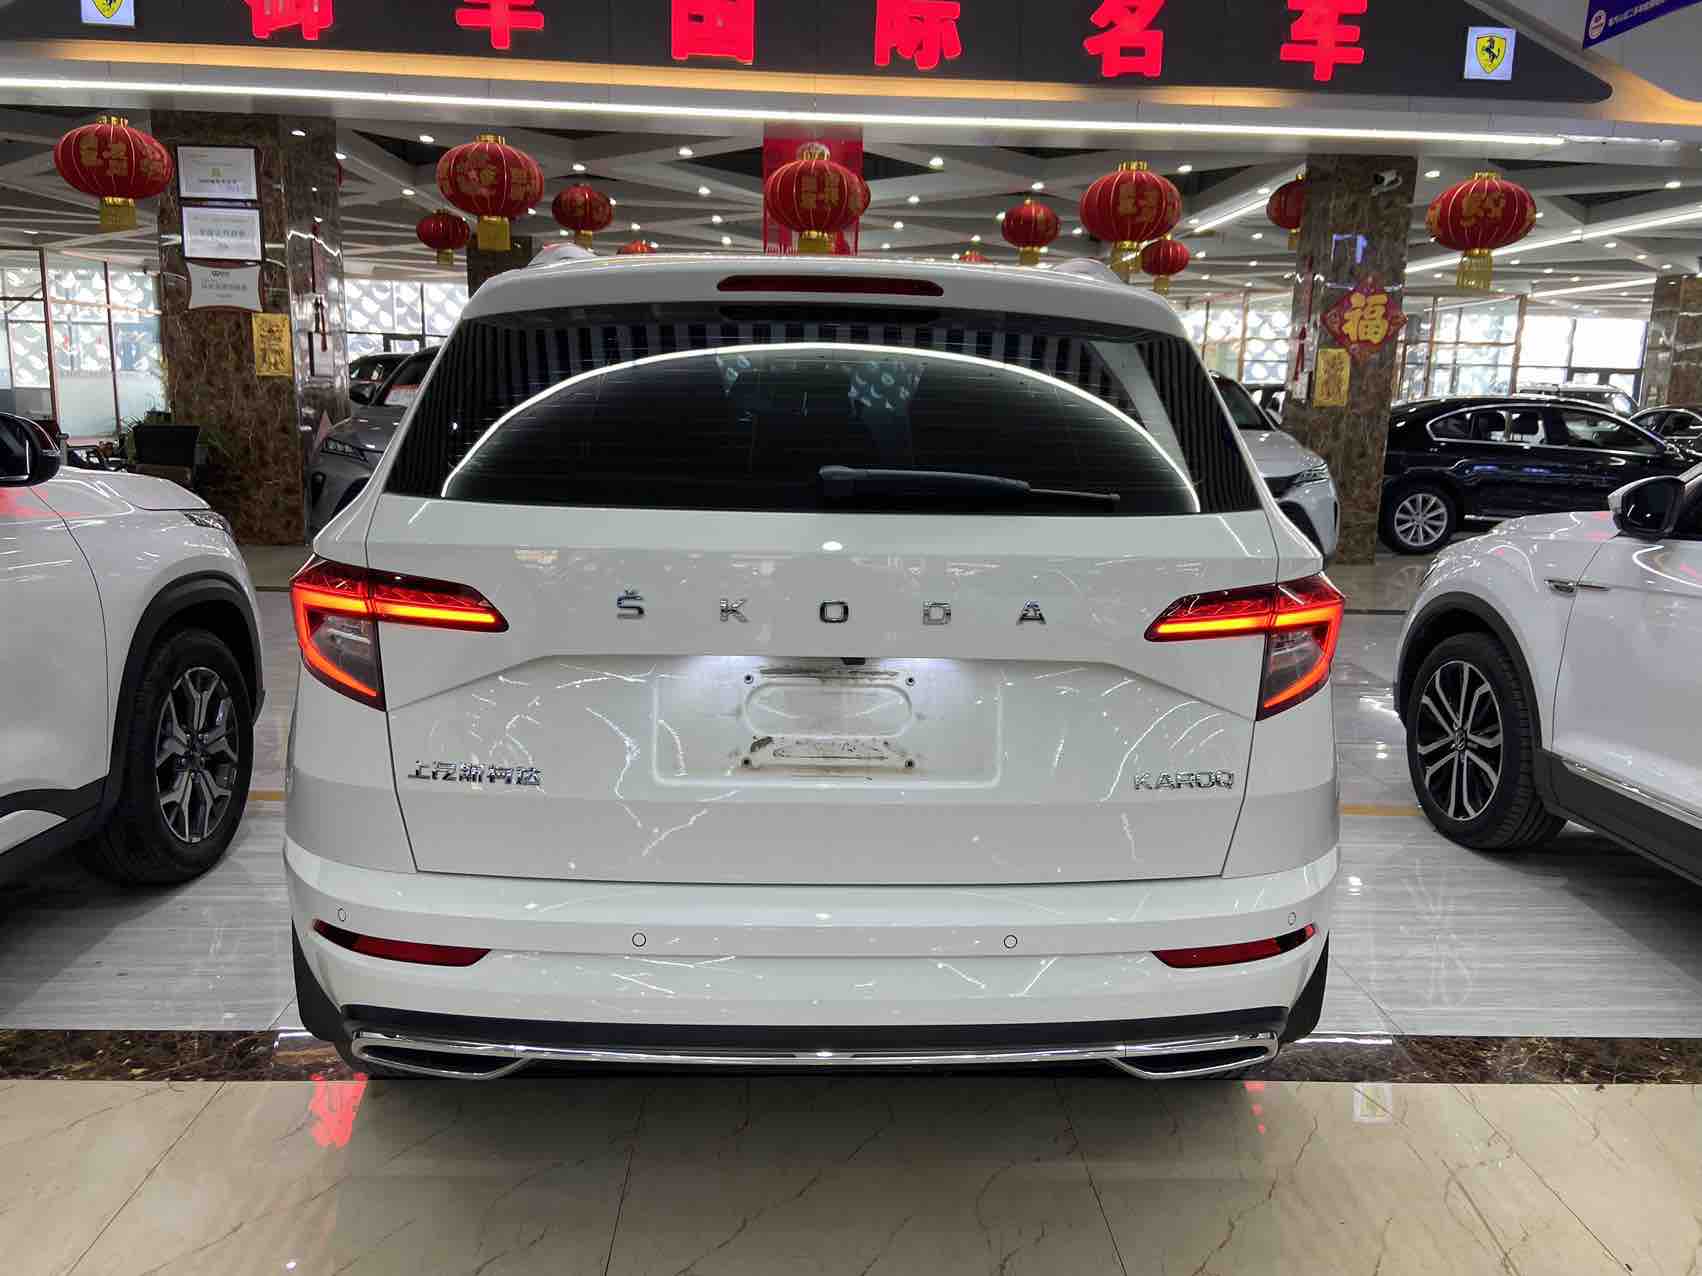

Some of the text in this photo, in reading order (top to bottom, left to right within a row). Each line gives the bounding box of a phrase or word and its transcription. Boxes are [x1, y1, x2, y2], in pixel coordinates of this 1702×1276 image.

[1343, 292, 1389, 345] 福
[617, 590, 1047, 625] ŠKODA
[1134, 770, 1234, 790] KAROQ
